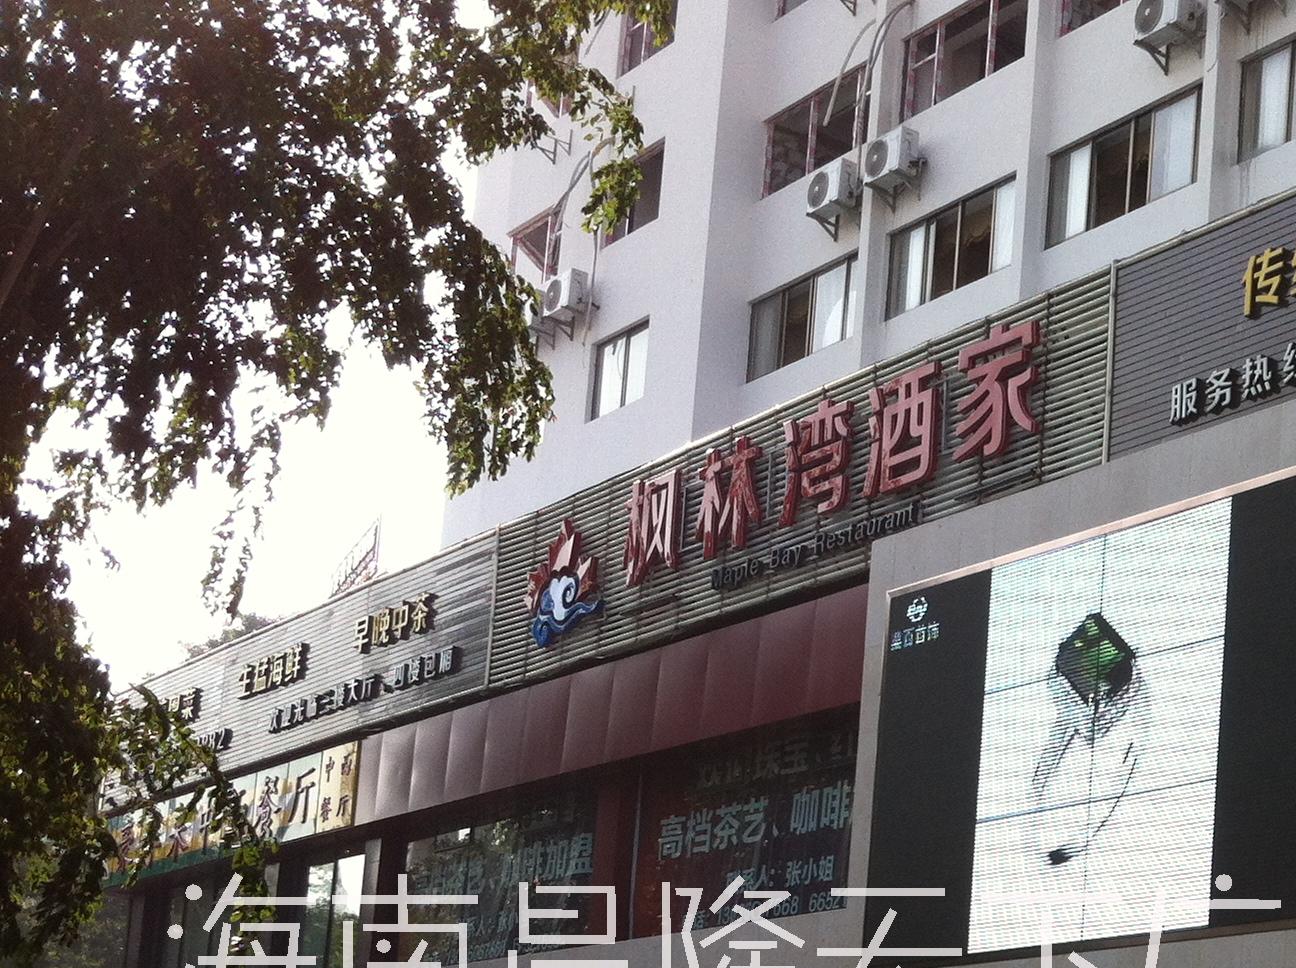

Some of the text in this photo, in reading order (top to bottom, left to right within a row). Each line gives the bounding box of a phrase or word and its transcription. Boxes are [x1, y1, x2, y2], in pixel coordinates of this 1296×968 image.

[624, 320, 1042, 588] 枫林湾酒家
[711, 559, 760, 589] Maple
[769, 544, 804, 571] Bay
[238, 642, 305, 698] 生猛海鲜
